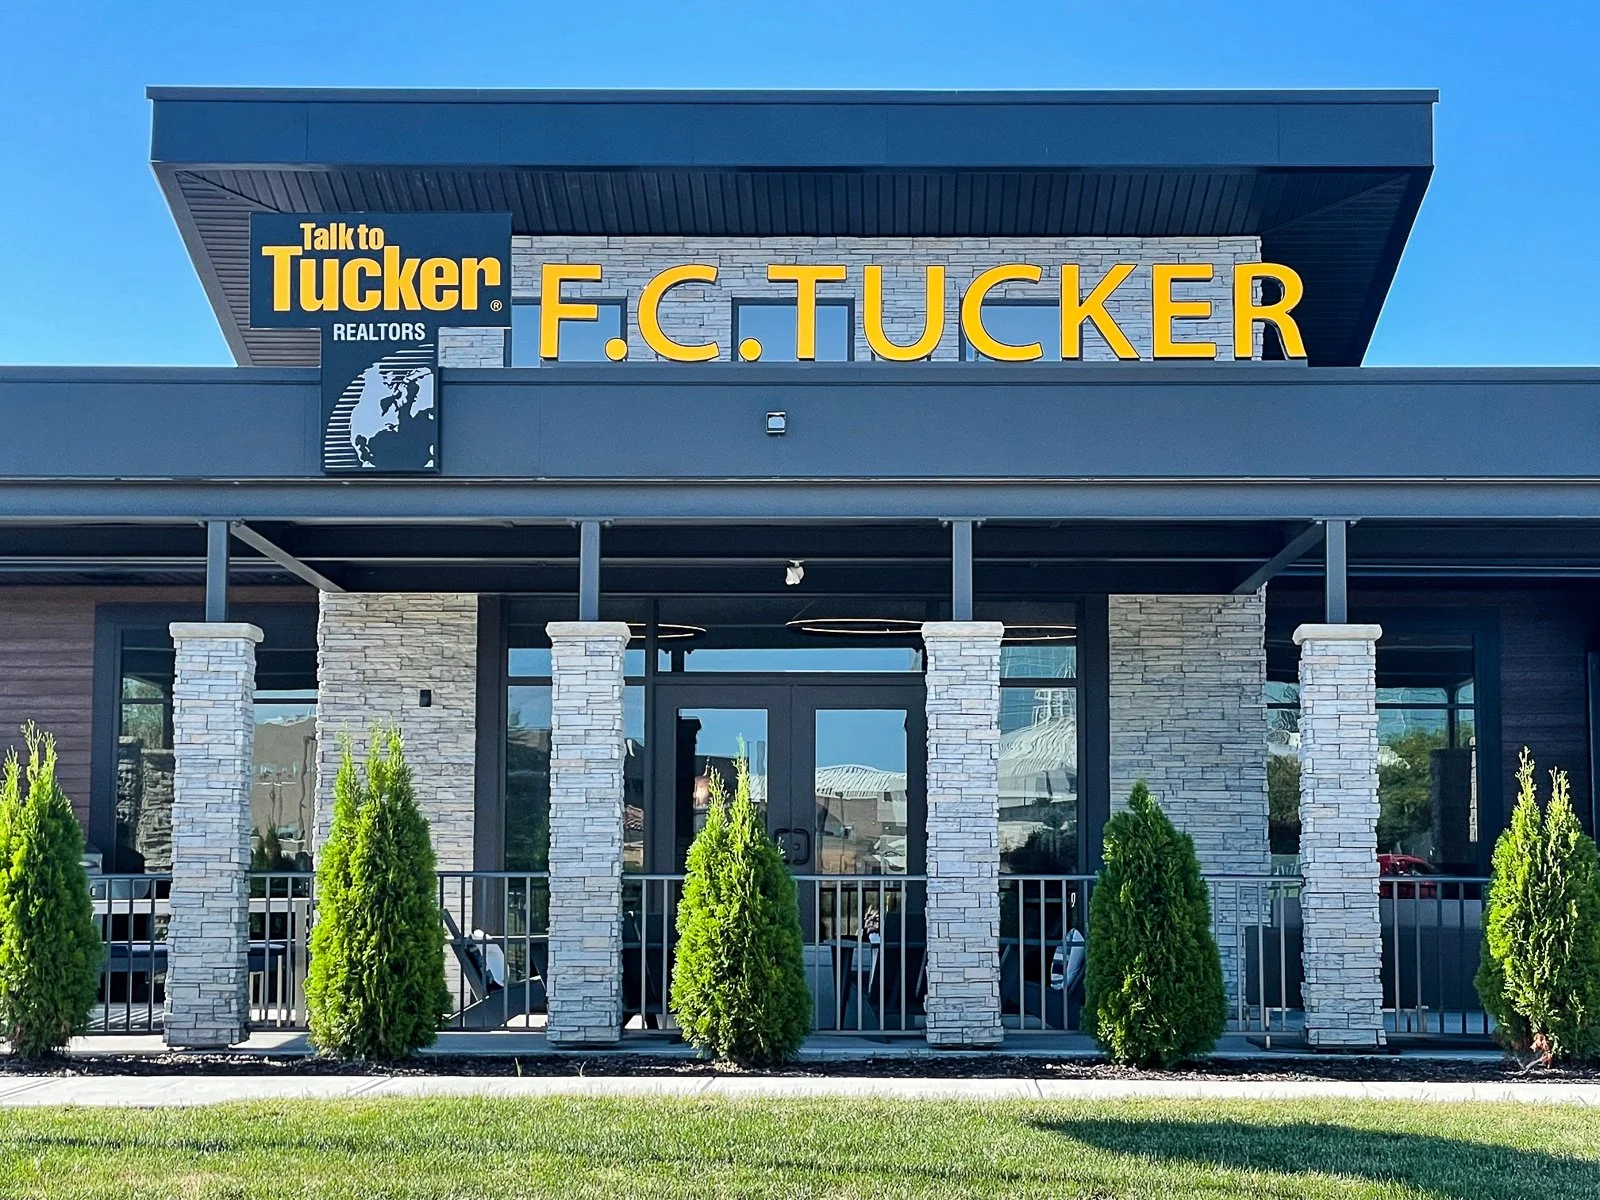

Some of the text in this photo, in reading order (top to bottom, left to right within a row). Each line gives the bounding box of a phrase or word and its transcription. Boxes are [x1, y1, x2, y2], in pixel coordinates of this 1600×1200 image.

[299, 222, 385, 250] Talk to
[261, 245, 501, 312] Tucker
[333, 322, 426, 341] REALTORS
